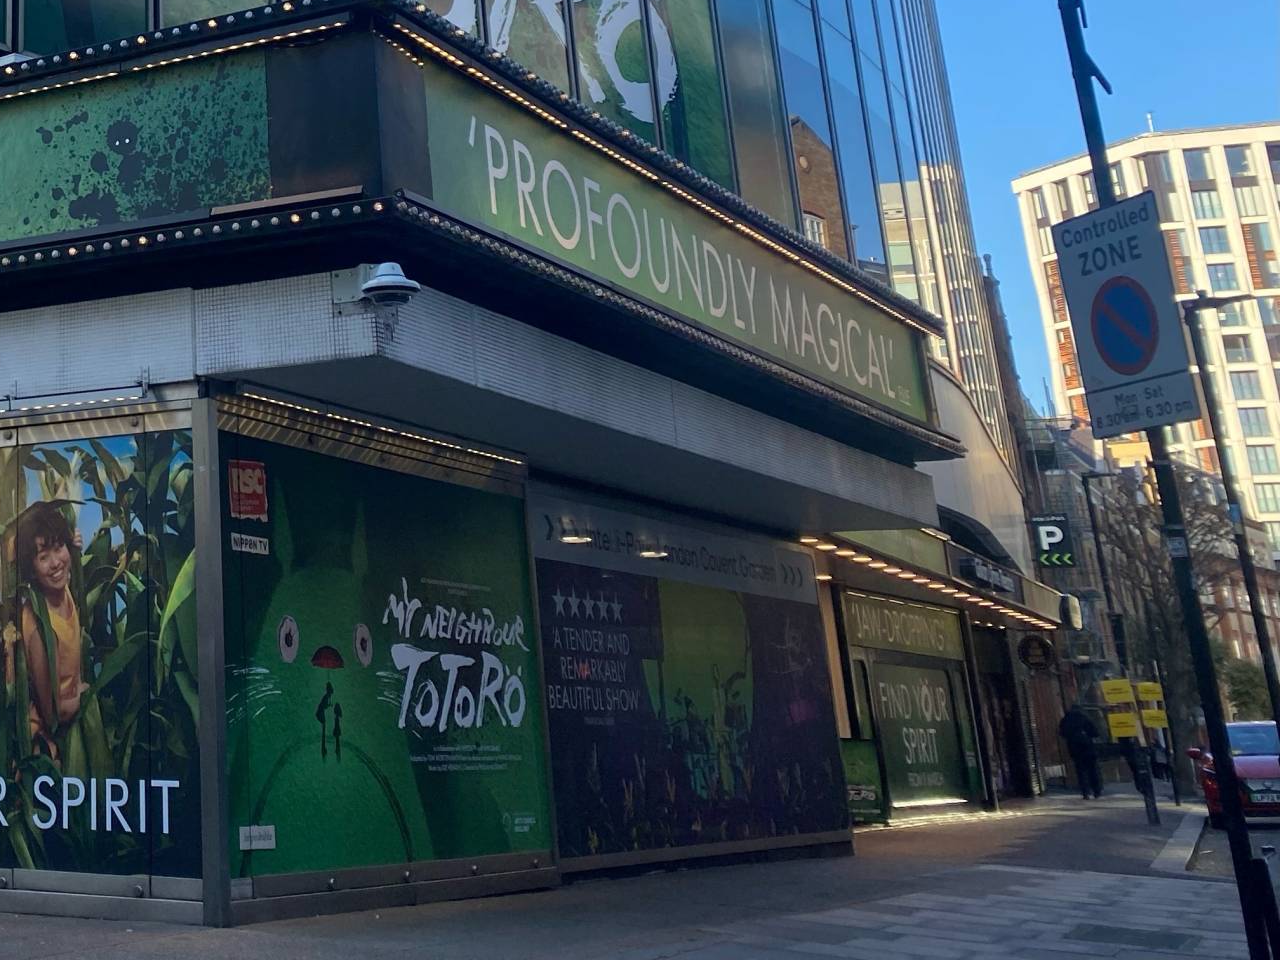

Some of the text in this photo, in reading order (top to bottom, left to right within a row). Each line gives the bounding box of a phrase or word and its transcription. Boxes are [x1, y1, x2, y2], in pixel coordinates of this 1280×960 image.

[1060, 202, 1149, 249] Controlled
[1078, 235, 1143, 277] ZONE
[259, 540, 268, 551] TV
[1038, 526, 1064, 550] P
[382, 577, 531, 652] MY NEIGHBOUR
[562, 626, 604, 653] TENDER
[607, 632, 630, 656] AND
[391, 642, 526, 732] TOTORO
[560, 656, 626, 683] REMARKABLY
[548, 684, 605, 711] BEAUTIFUL
[879, 682, 913, 720] FIND
[902, 726, 940, 765] SPIRIT
[32, 774, 180, 835] SPIRIT
